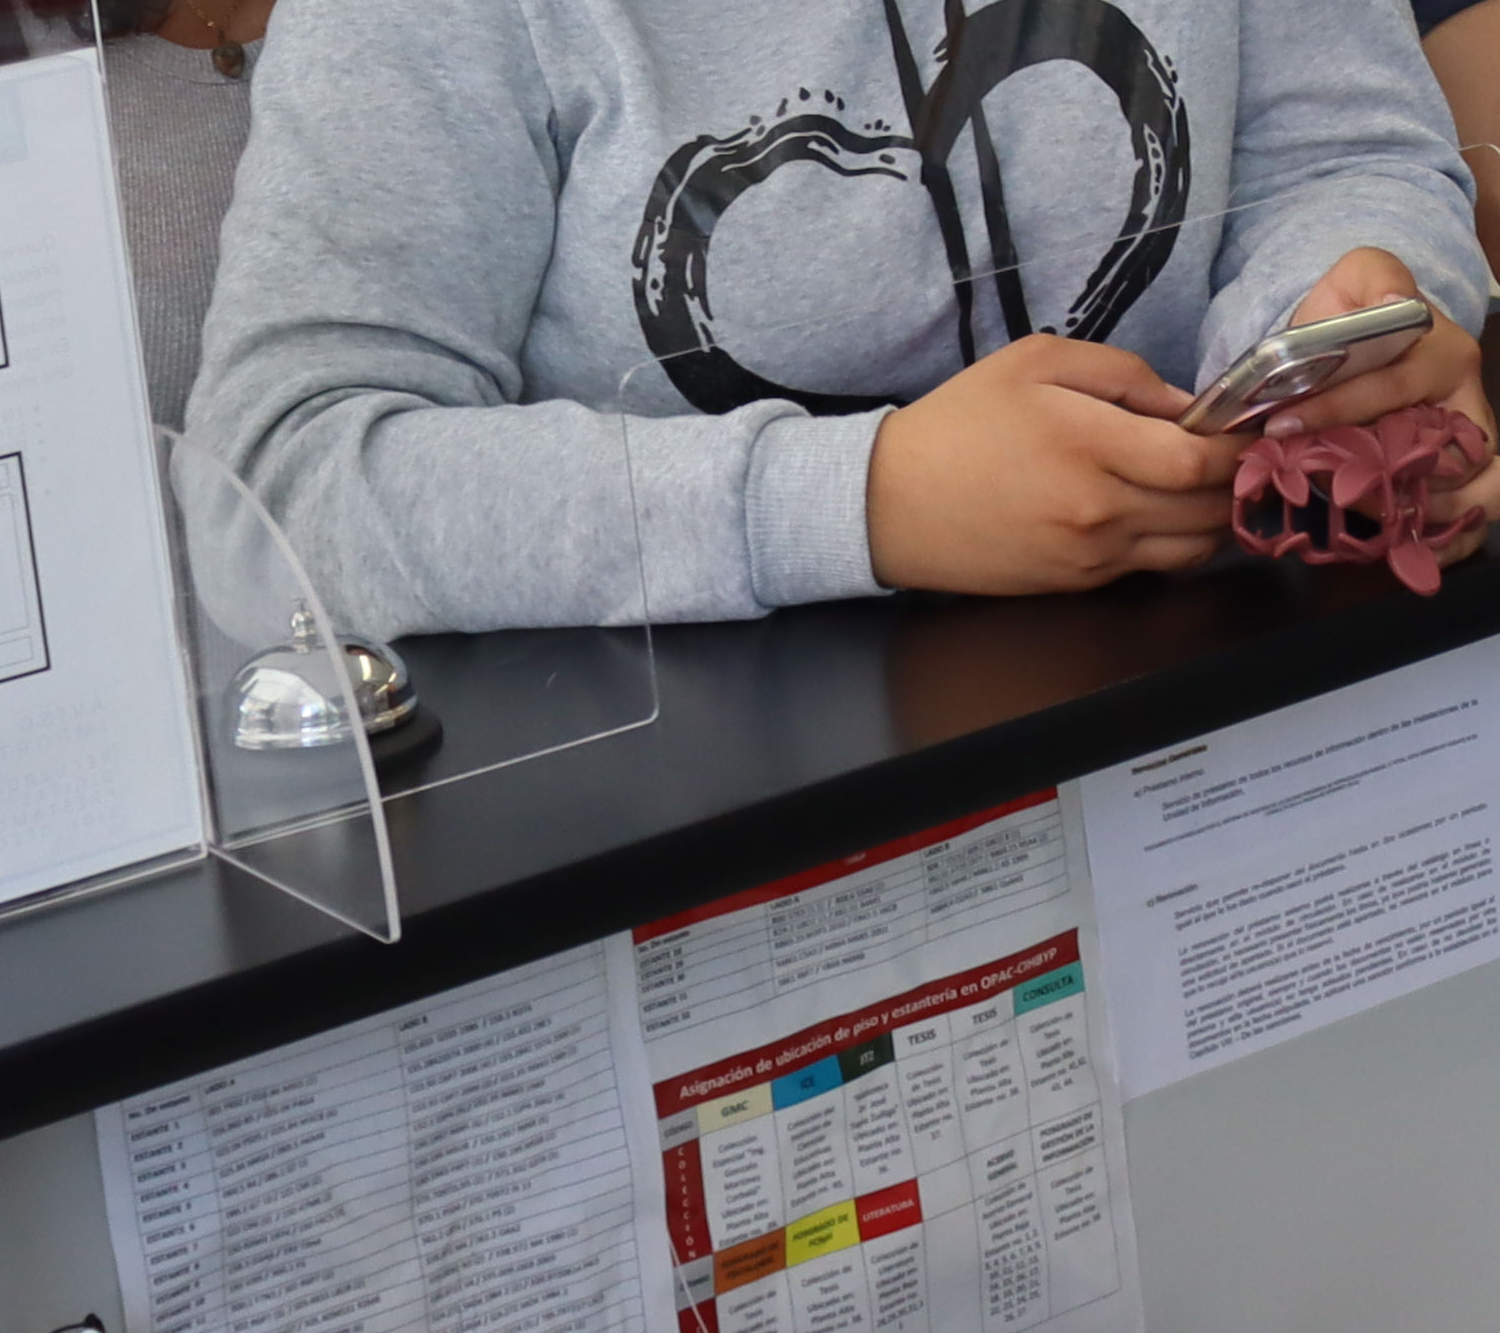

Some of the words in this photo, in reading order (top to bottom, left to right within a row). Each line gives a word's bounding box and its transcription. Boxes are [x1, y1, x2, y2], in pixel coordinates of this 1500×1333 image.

[678, 1064, 755, 1101] Asignación
[755, 1060, 774, 1078] de
[774, 1034, 833, 1071] ubicación
[834, 1026, 851, 1043] de
[852, 1017, 880, 1040] piso
[880, 1016, 890, 1031] y
[891, 986, 958, 1020] estantería
[960, 983, 979, 999] en
[979, 946, 1058, 990] OPAC-CIHBYP
[907, 1028, 937, 1046] TESIS
[971, 1007, 998, 1026] TESIS
[1022, 974, 1075, 1003] CONSULTA
